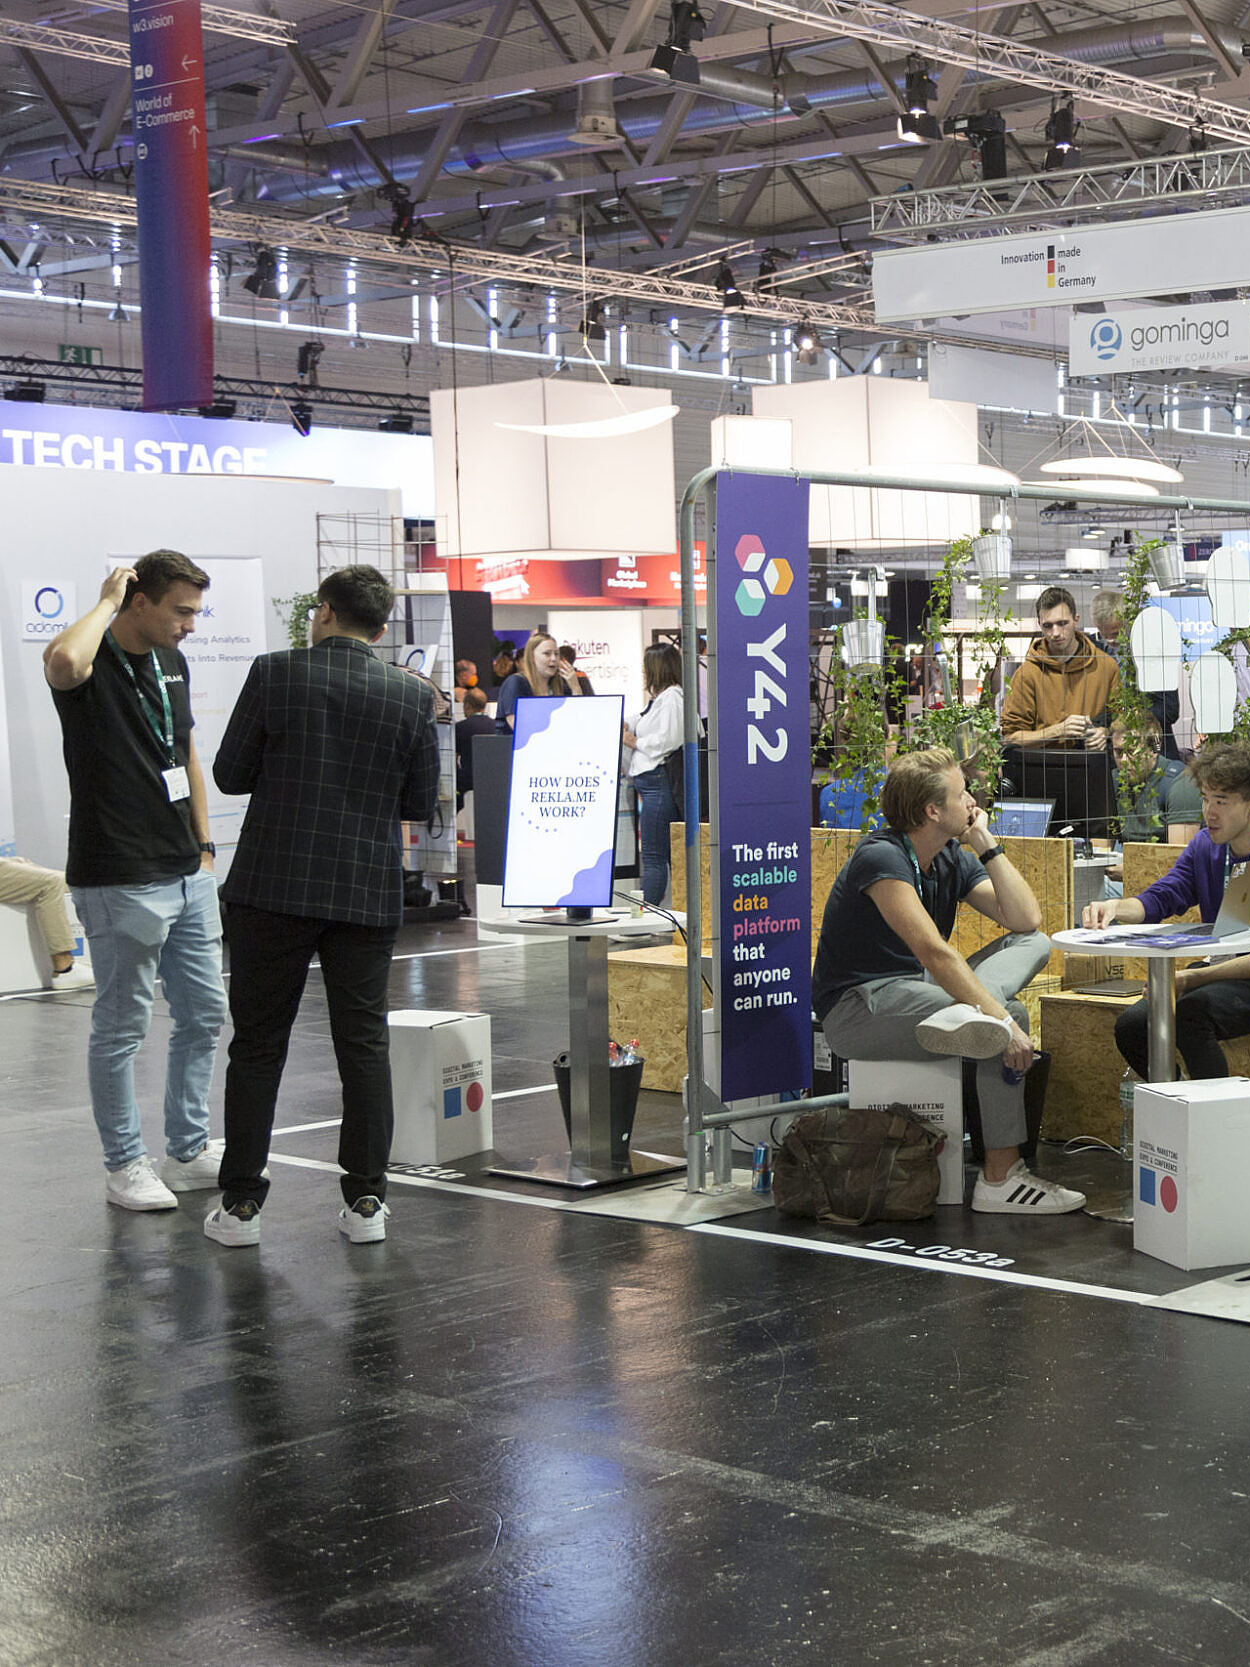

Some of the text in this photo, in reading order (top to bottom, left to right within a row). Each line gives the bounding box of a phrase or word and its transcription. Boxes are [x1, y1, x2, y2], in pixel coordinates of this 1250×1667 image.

[135, 93, 172, 112] World of
[136, 108, 195, 129] E-Commerce
[1001, 250, 1045, 265] Innovation
[1057, 246, 1081, 259] made
[1058, 262, 1066, 273] in
[1058, 275, 1096, 288] Germany
[1131, 317, 1229, 351] gominga
[1149, 355, 1181, 366] REVIEW
[1185, 350, 1229, 363] COMPANY
[2, 428, 267, 475] TECH STAGE
[746, 622, 788, 765] Y42
[529, 776, 600, 788] HOW DOES
[531, 791, 596, 803] REKLA.ME
[539, 806, 586, 817] WORK?
[732, 842, 799, 862] The first
[733, 866, 797, 887] scalable
[733, 894, 768, 912] data
[733, 916, 800, 941] platform
[733, 943, 765, 962] that
[733, 967, 791, 988] anyone
[734, 991, 798, 1011] can run.
[865, 1237, 1015, 1267] D-053a
